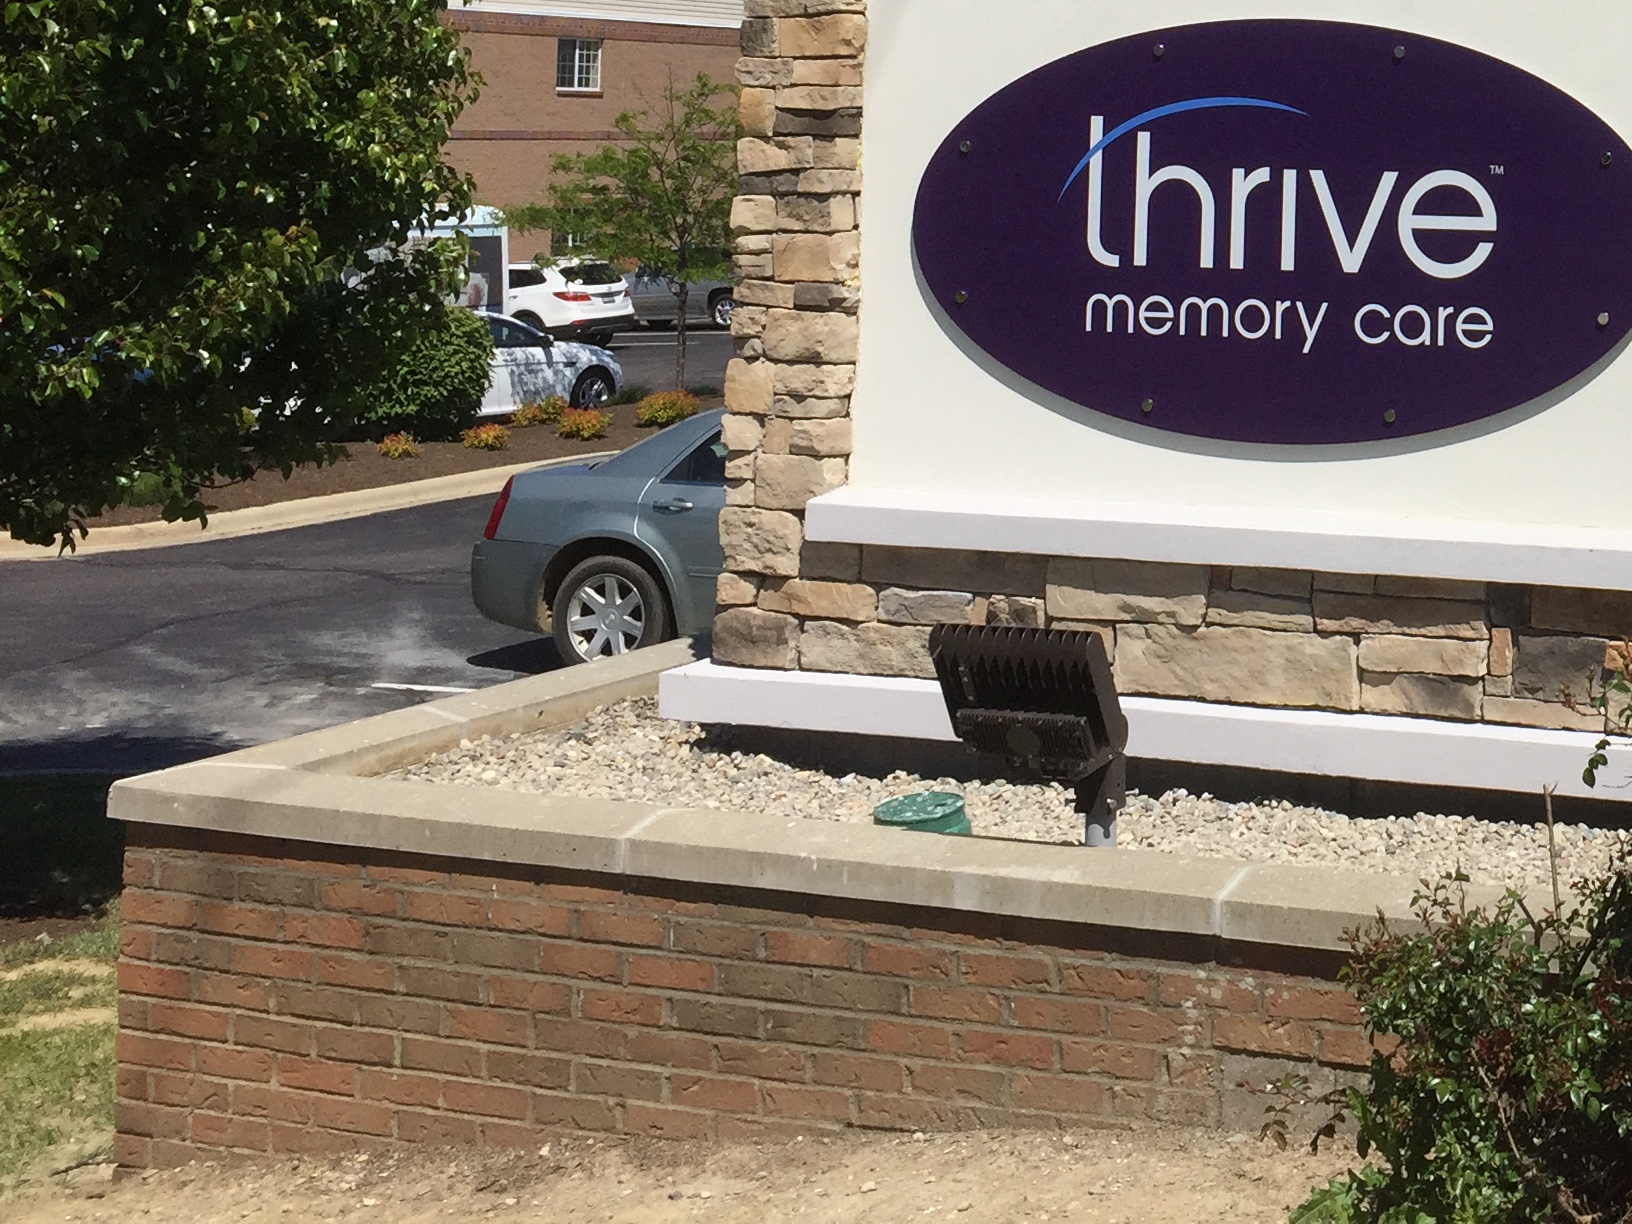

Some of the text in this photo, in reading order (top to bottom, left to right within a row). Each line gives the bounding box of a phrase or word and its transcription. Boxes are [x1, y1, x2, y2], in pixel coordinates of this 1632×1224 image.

[1085, 115, 1498, 279] thrive
[1085, 293, 1494, 354] memory care
